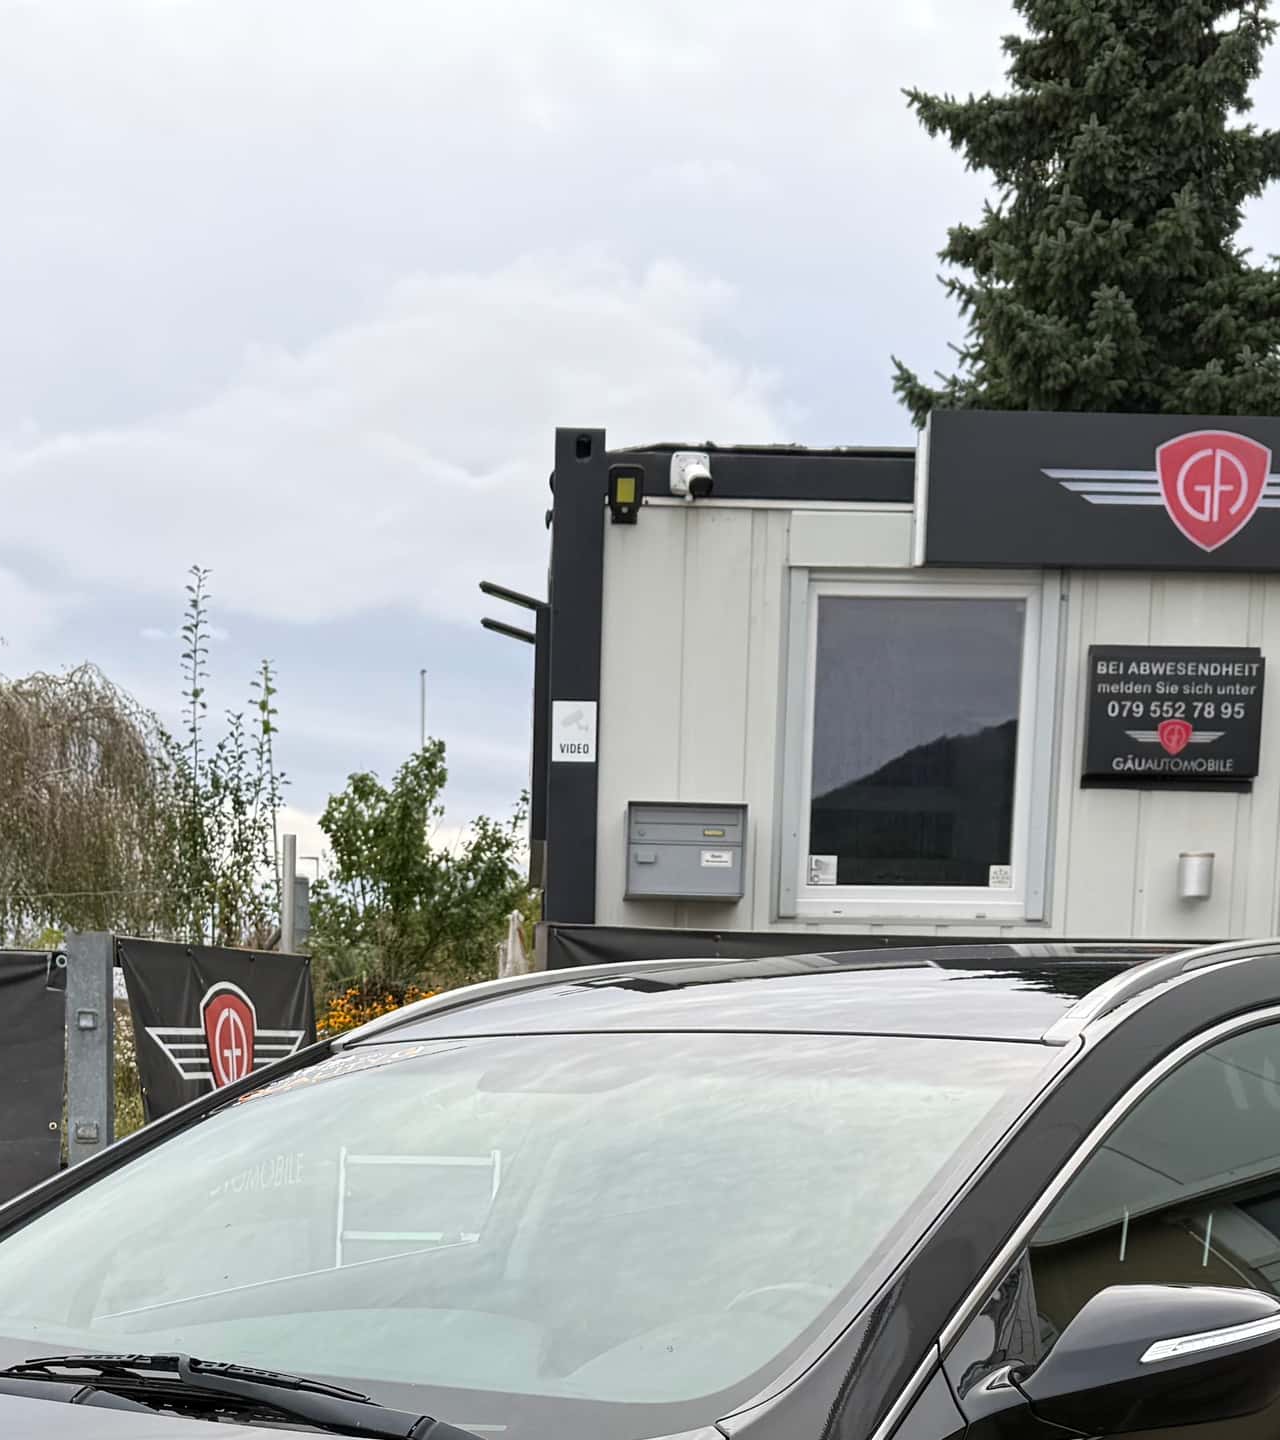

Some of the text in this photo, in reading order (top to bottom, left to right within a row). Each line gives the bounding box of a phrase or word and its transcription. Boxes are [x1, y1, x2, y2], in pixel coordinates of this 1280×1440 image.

[1096, 661, 1260, 677] BEI ABWESENDHEIT
[1097, 681, 1256, 696] melden Sie sich unter
[1107, 700, 1245, 719] 079 552 78 95
[559, 743, 590, 755] VIDEO
[1111, 755, 1234, 773] GÄUAUTOMOBILE
